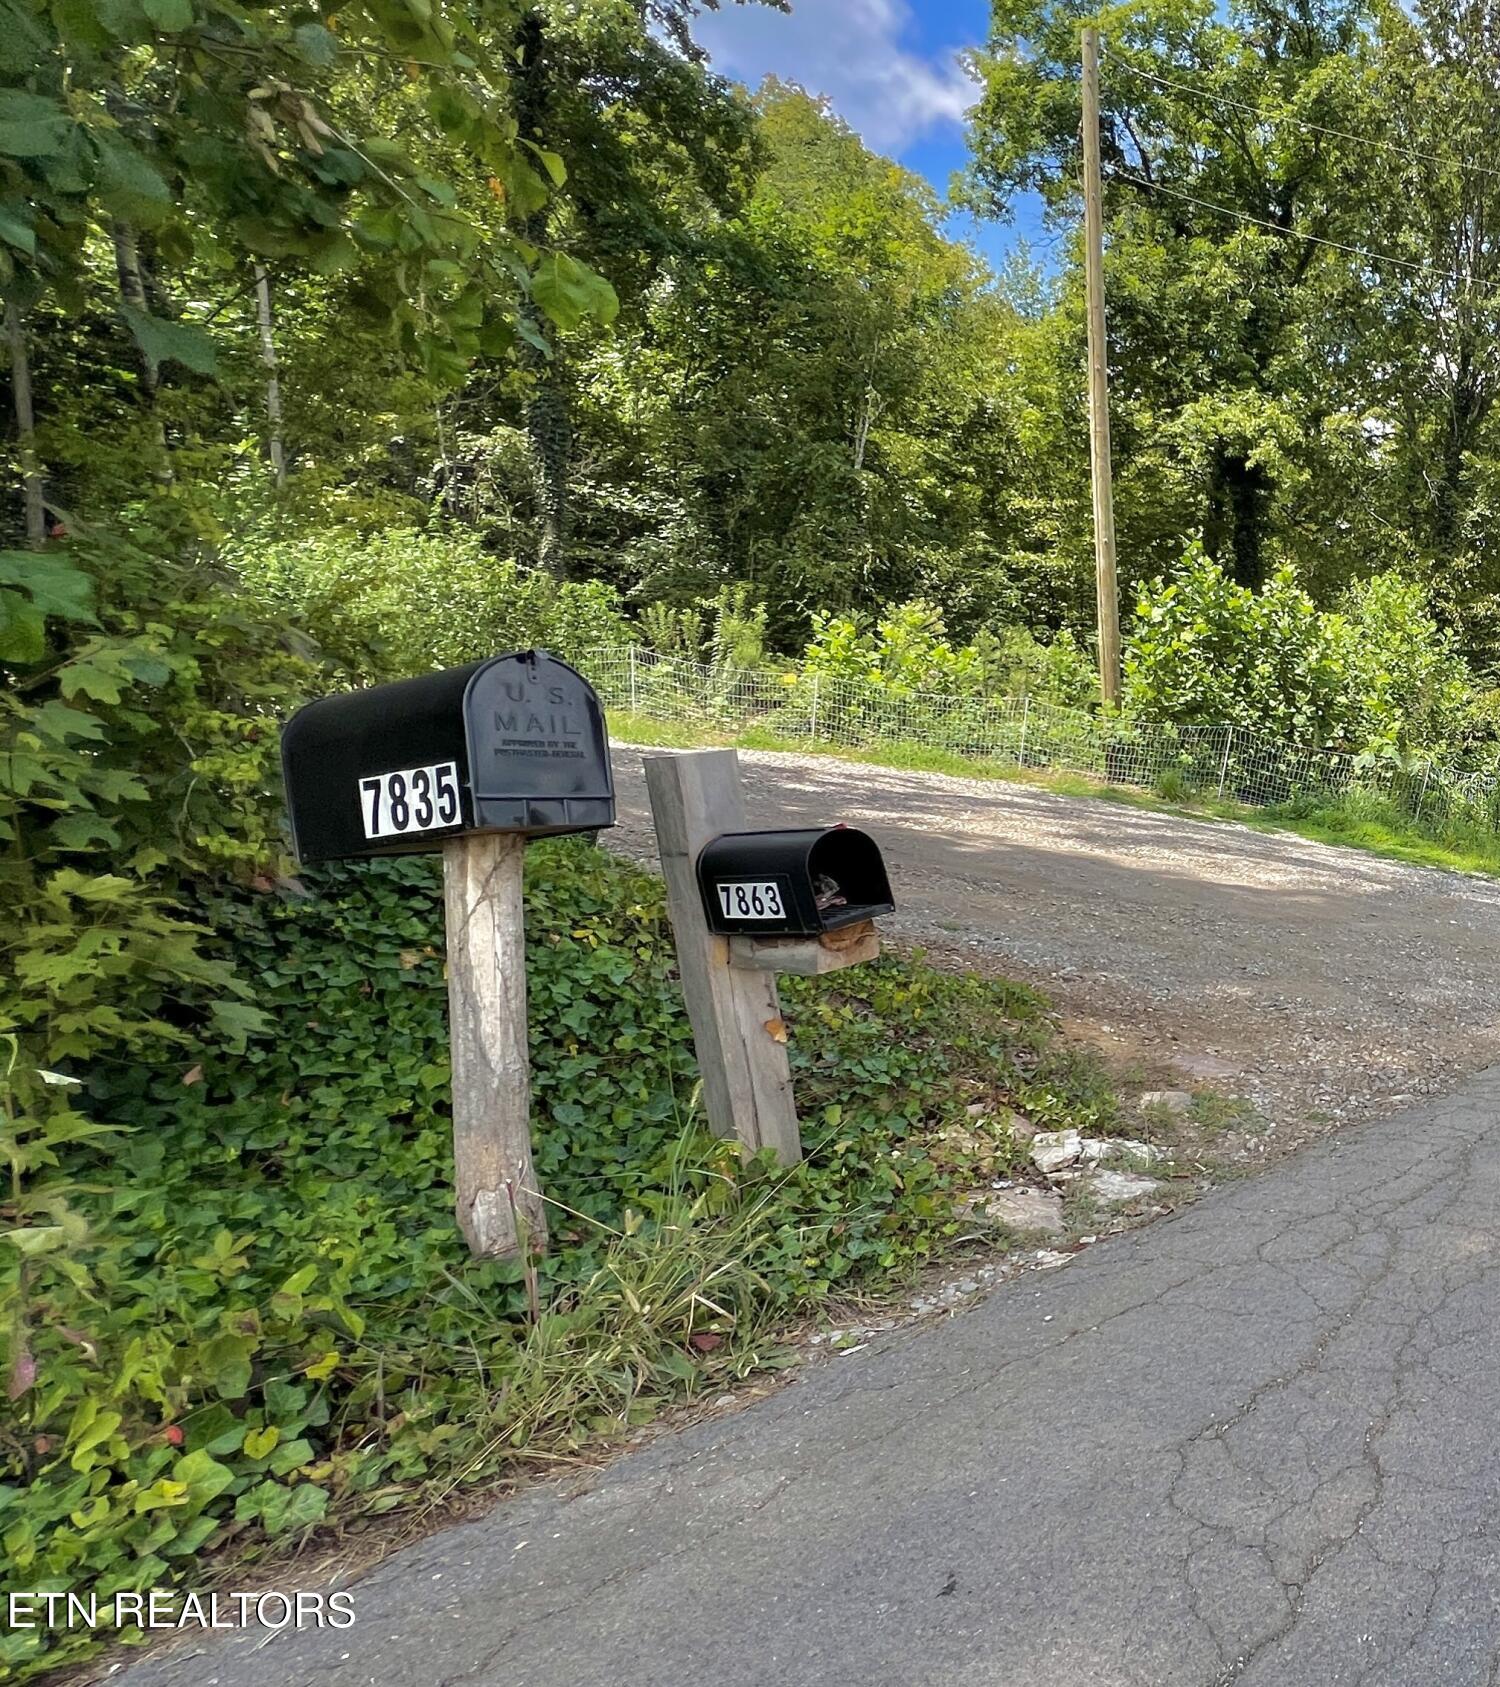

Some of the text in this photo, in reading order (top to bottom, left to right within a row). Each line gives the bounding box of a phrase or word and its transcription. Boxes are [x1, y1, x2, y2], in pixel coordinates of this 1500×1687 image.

[495, 711, 582, 735] MAIL
[362, 765, 457, 835] 7835
[720, 885, 781, 916] 7863
